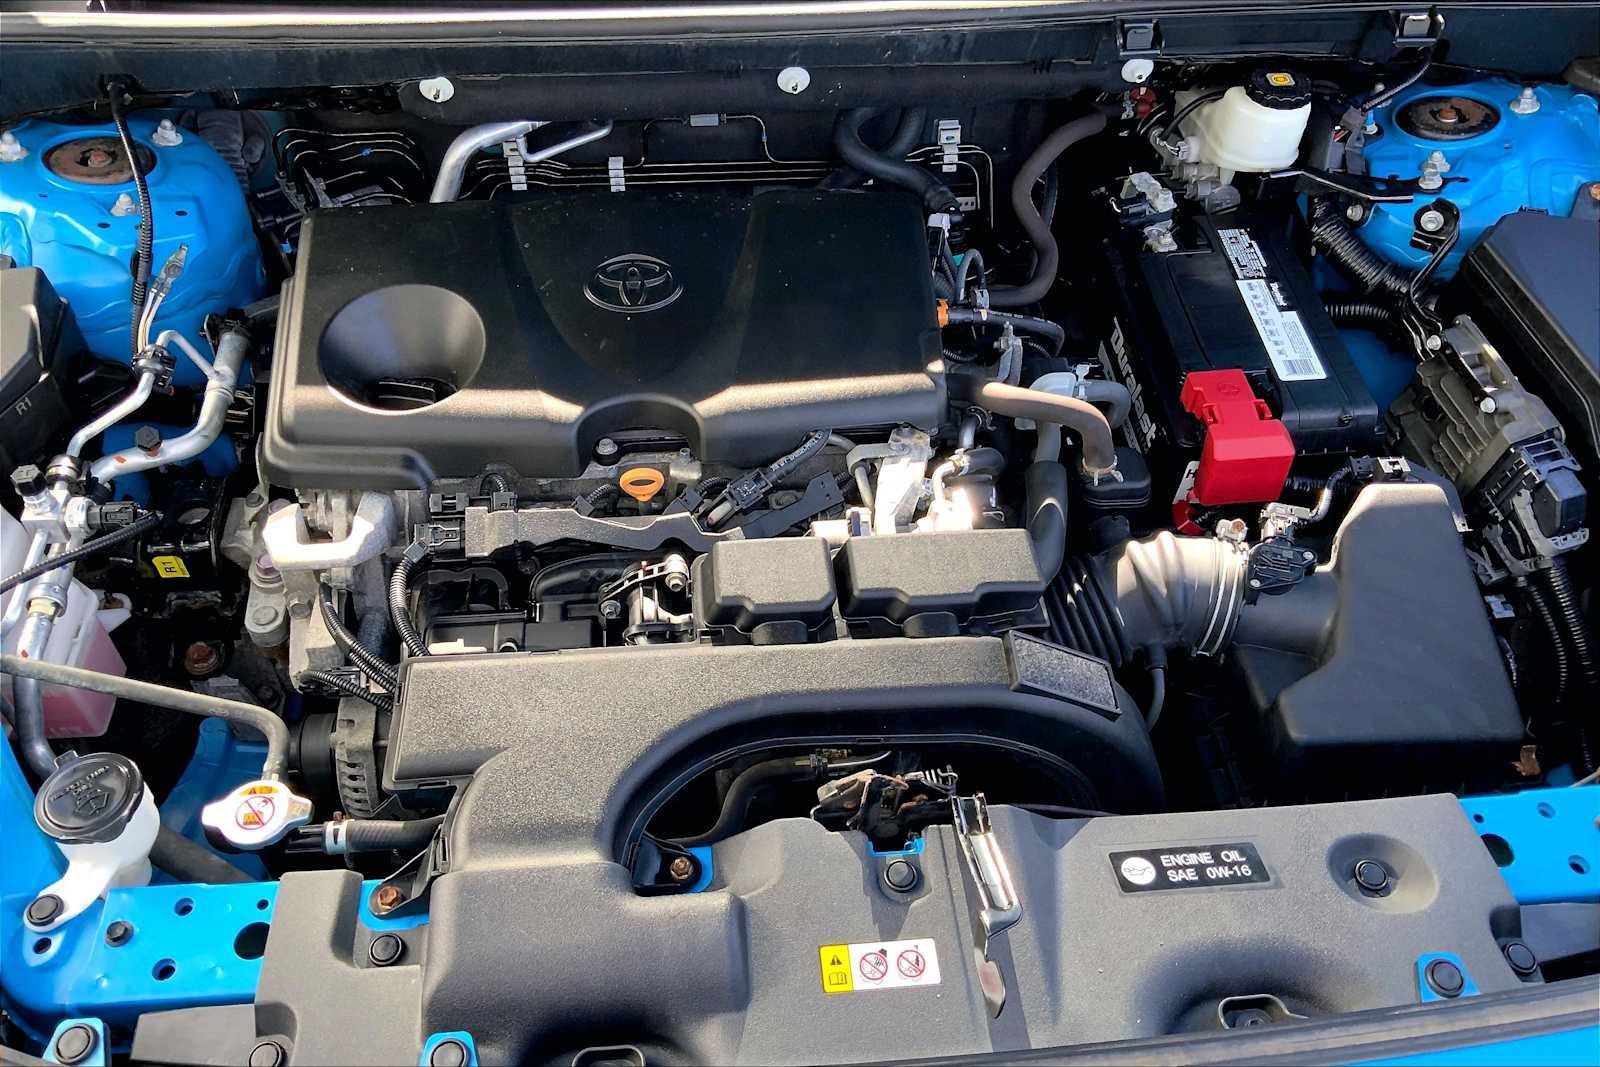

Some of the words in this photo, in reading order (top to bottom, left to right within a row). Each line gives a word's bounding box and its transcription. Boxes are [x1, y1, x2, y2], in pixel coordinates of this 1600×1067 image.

[1110, 316, 1157, 448] Duralast
[1159, 852, 1215, 867] ENGINE
[1220, 850, 1247, 862] OIL
[1166, 868, 1199, 882] SAE
[1206, 864, 1252, 879] 0W-16
